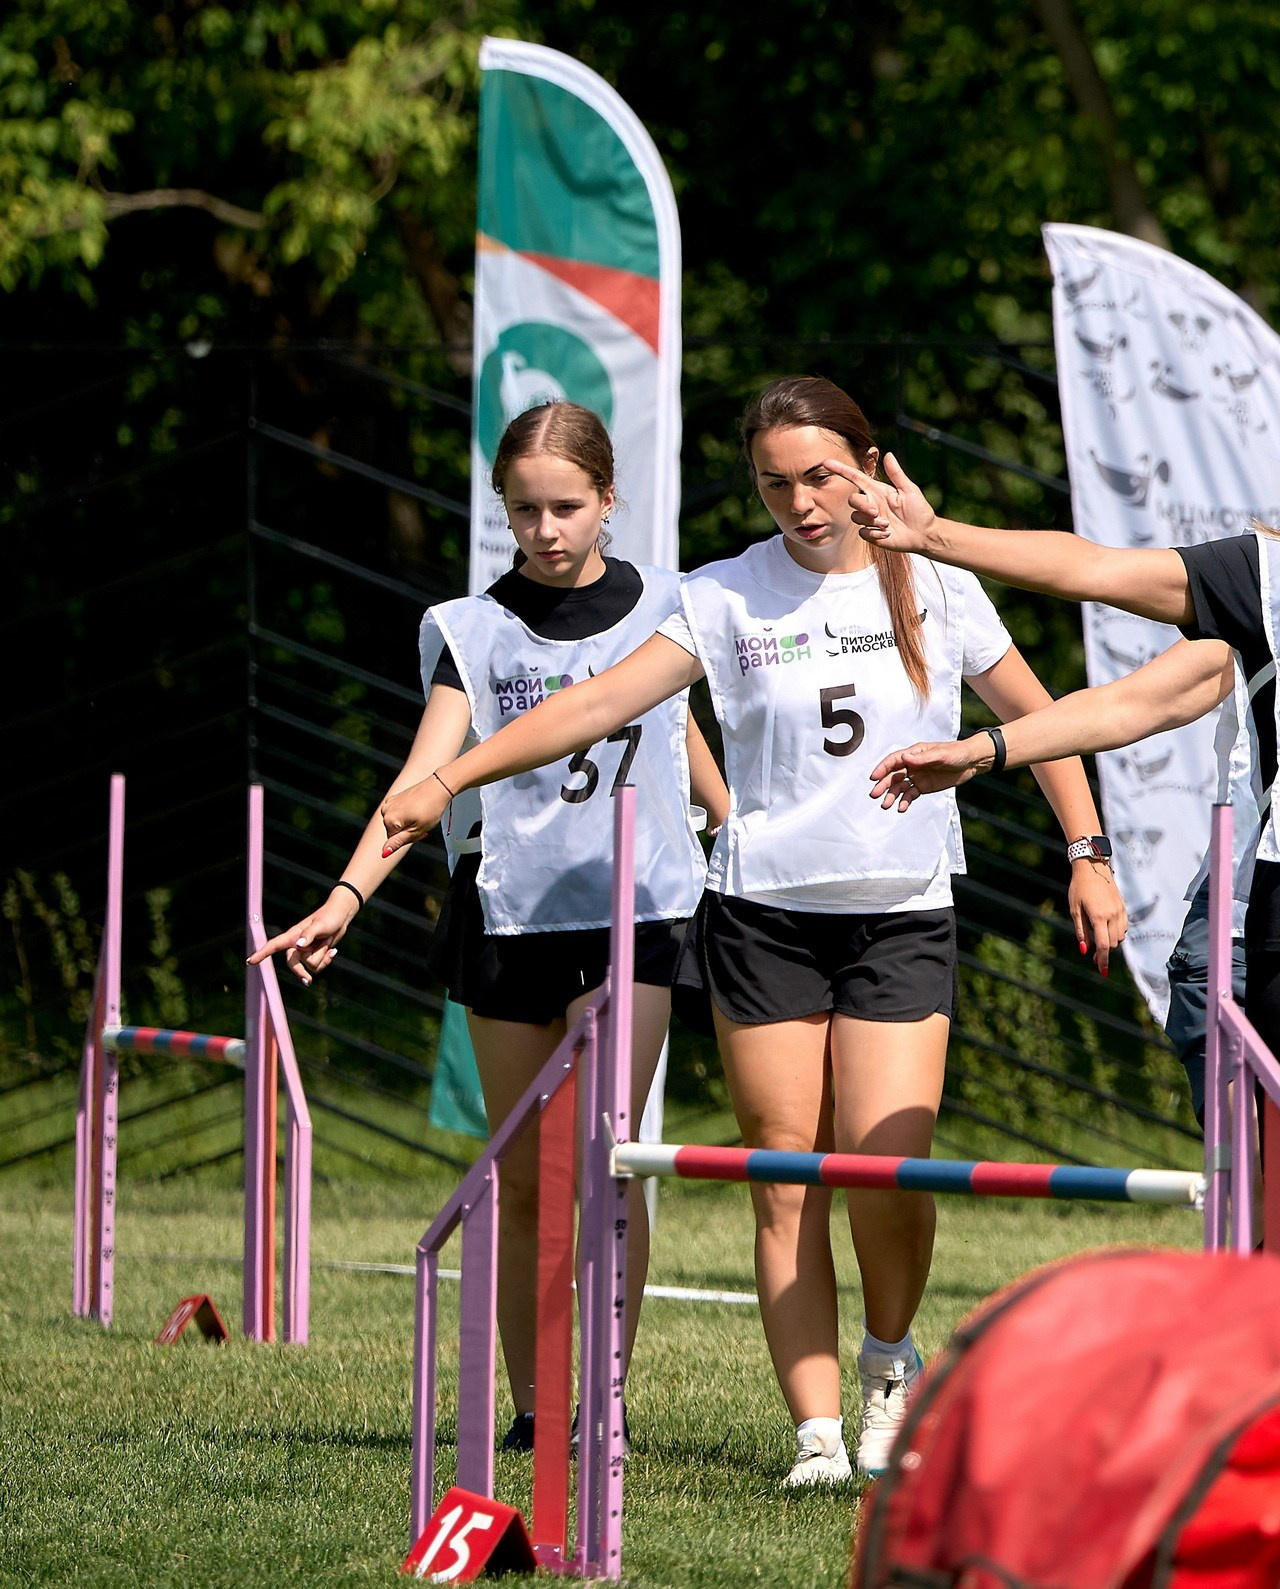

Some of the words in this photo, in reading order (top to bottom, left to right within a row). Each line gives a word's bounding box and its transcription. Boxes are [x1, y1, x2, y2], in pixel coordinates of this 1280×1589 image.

[840, 631, 896, 646] ПИТОМЦ
[842, 646, 848, 654] В
[820, 683, 865, 757] 5
[561, 724, 643, 804] 37
[415, 1504, 494, 1584] 15
